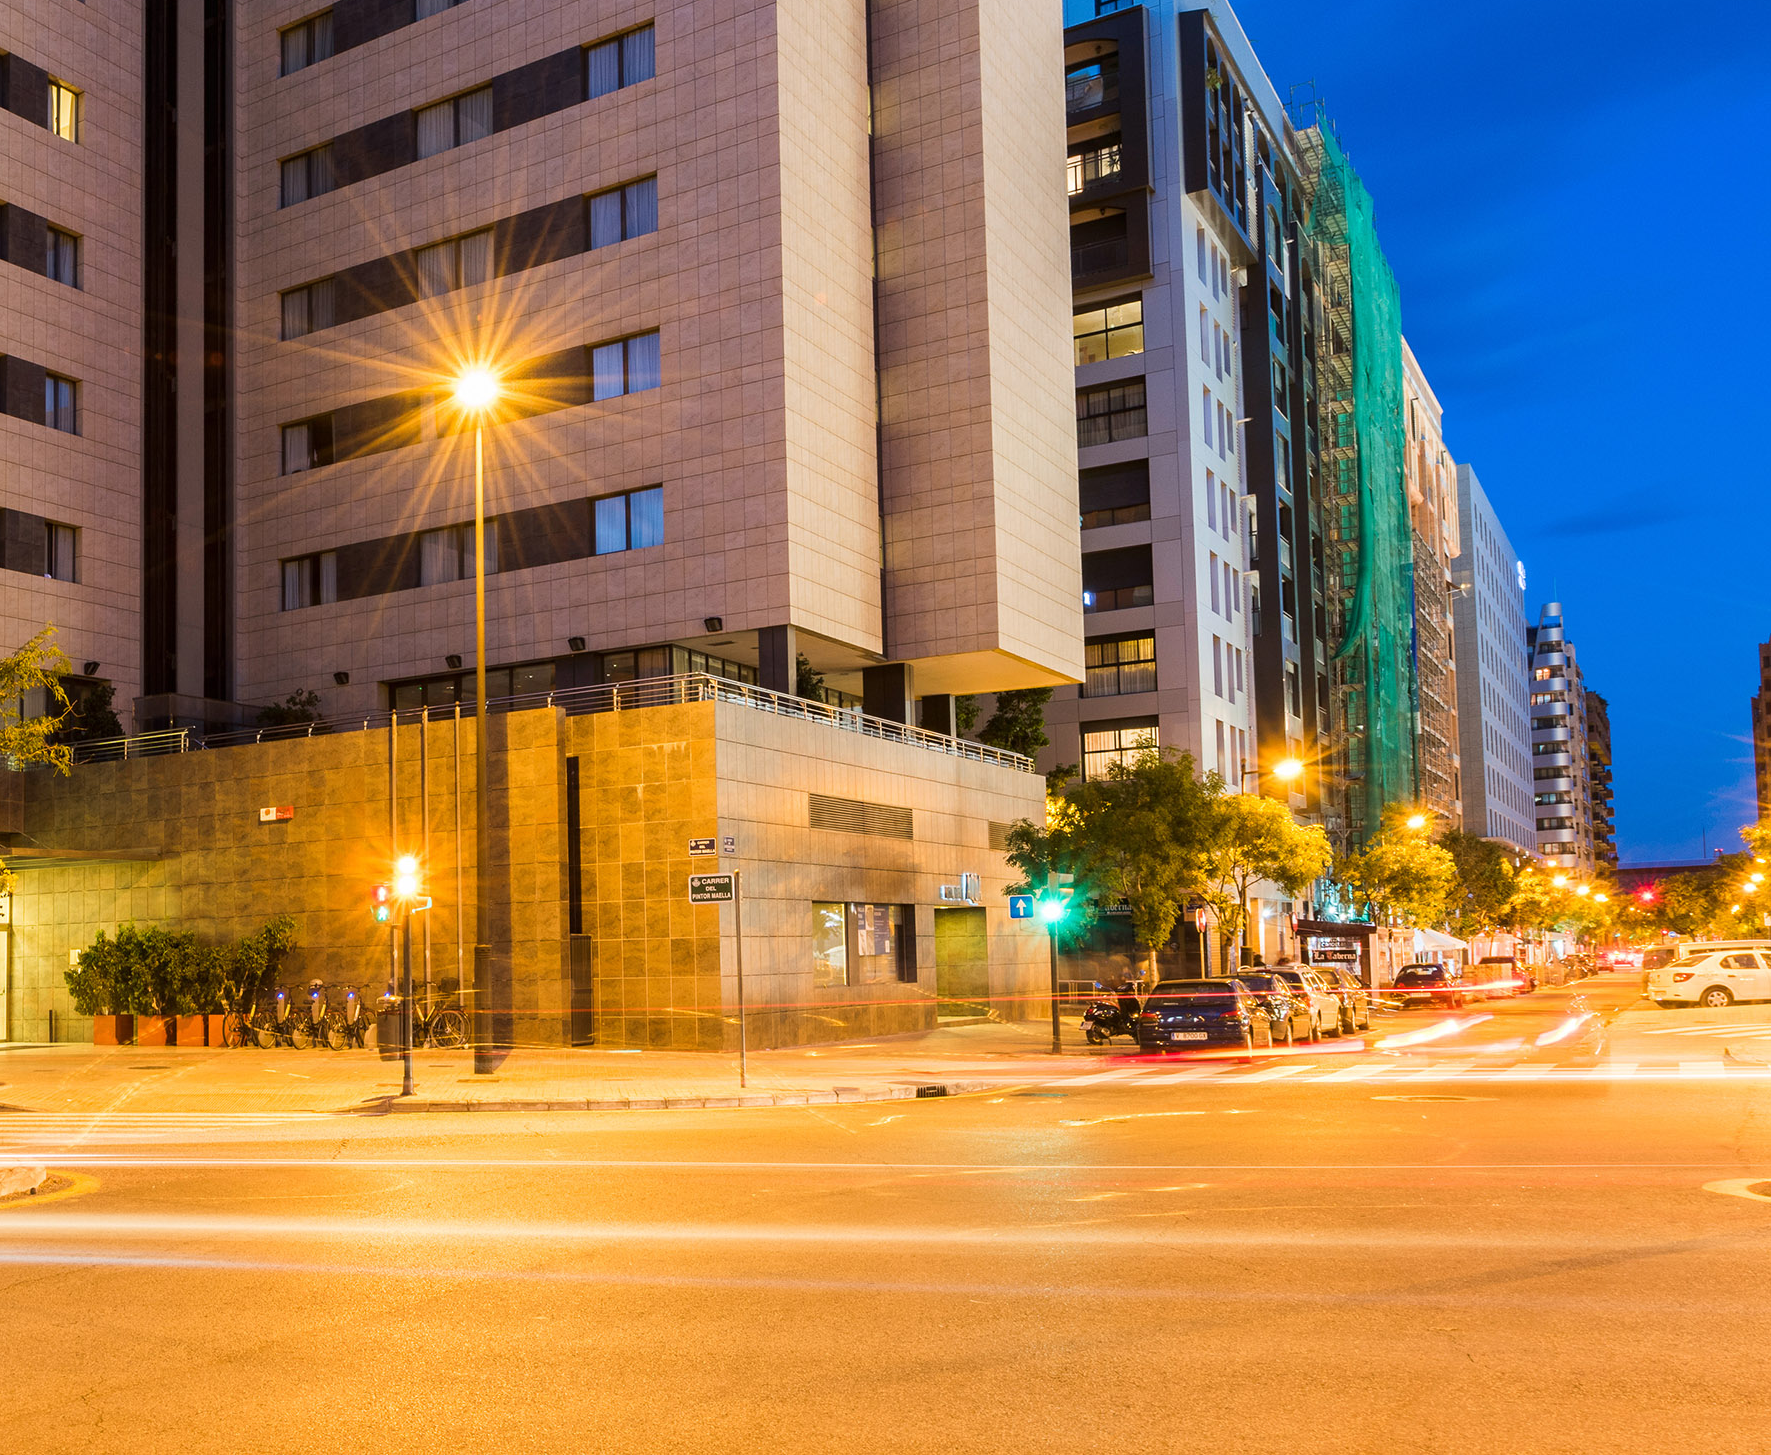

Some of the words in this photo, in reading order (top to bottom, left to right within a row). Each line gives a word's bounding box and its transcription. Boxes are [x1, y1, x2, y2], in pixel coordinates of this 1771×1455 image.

[701, 877, 729, 885] CARRER
[1313, 950, 1325, 960] La
[1326, 950, 1356, 960] Taberna
